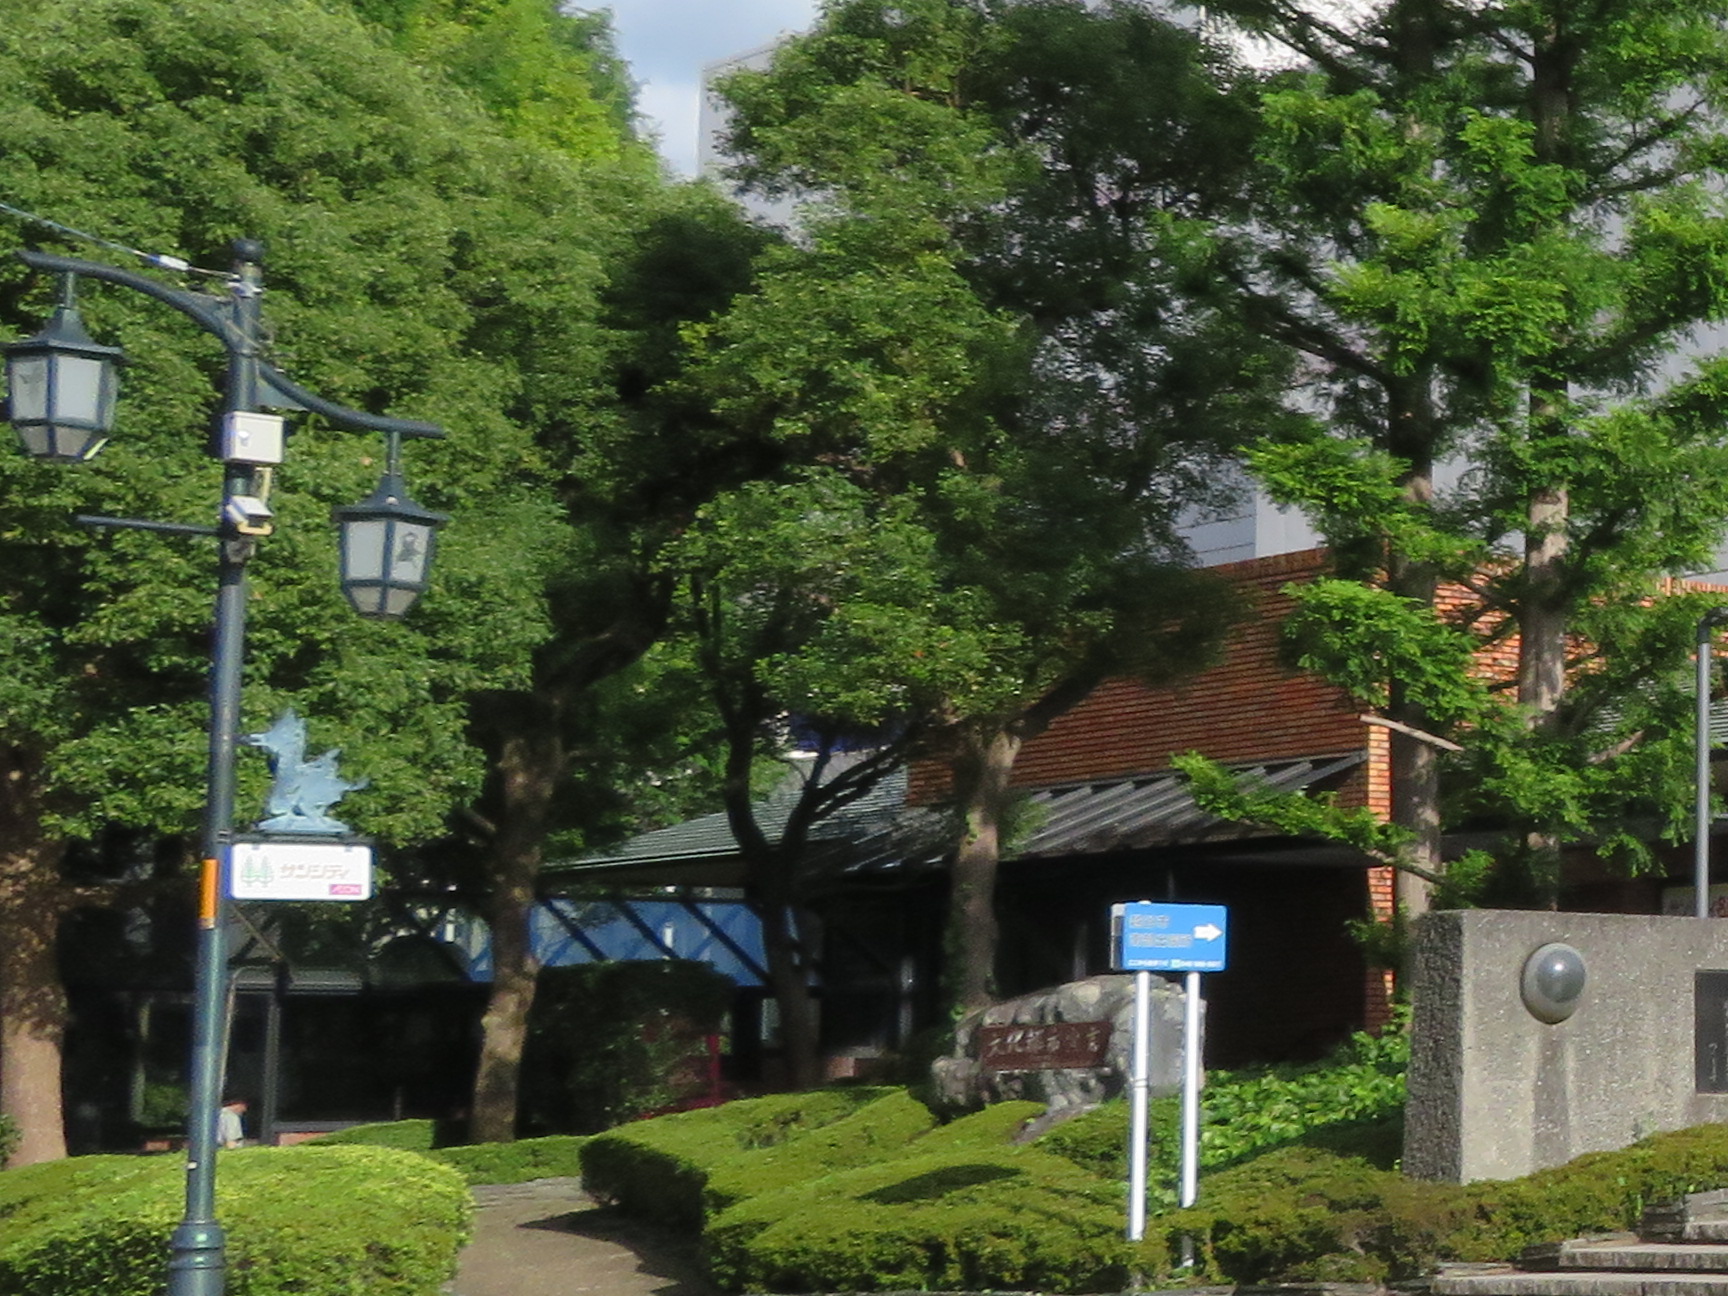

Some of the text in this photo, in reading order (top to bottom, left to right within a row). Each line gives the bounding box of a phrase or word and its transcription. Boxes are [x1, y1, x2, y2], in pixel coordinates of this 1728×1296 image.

[280, 864, 350, 880] サンシティ
